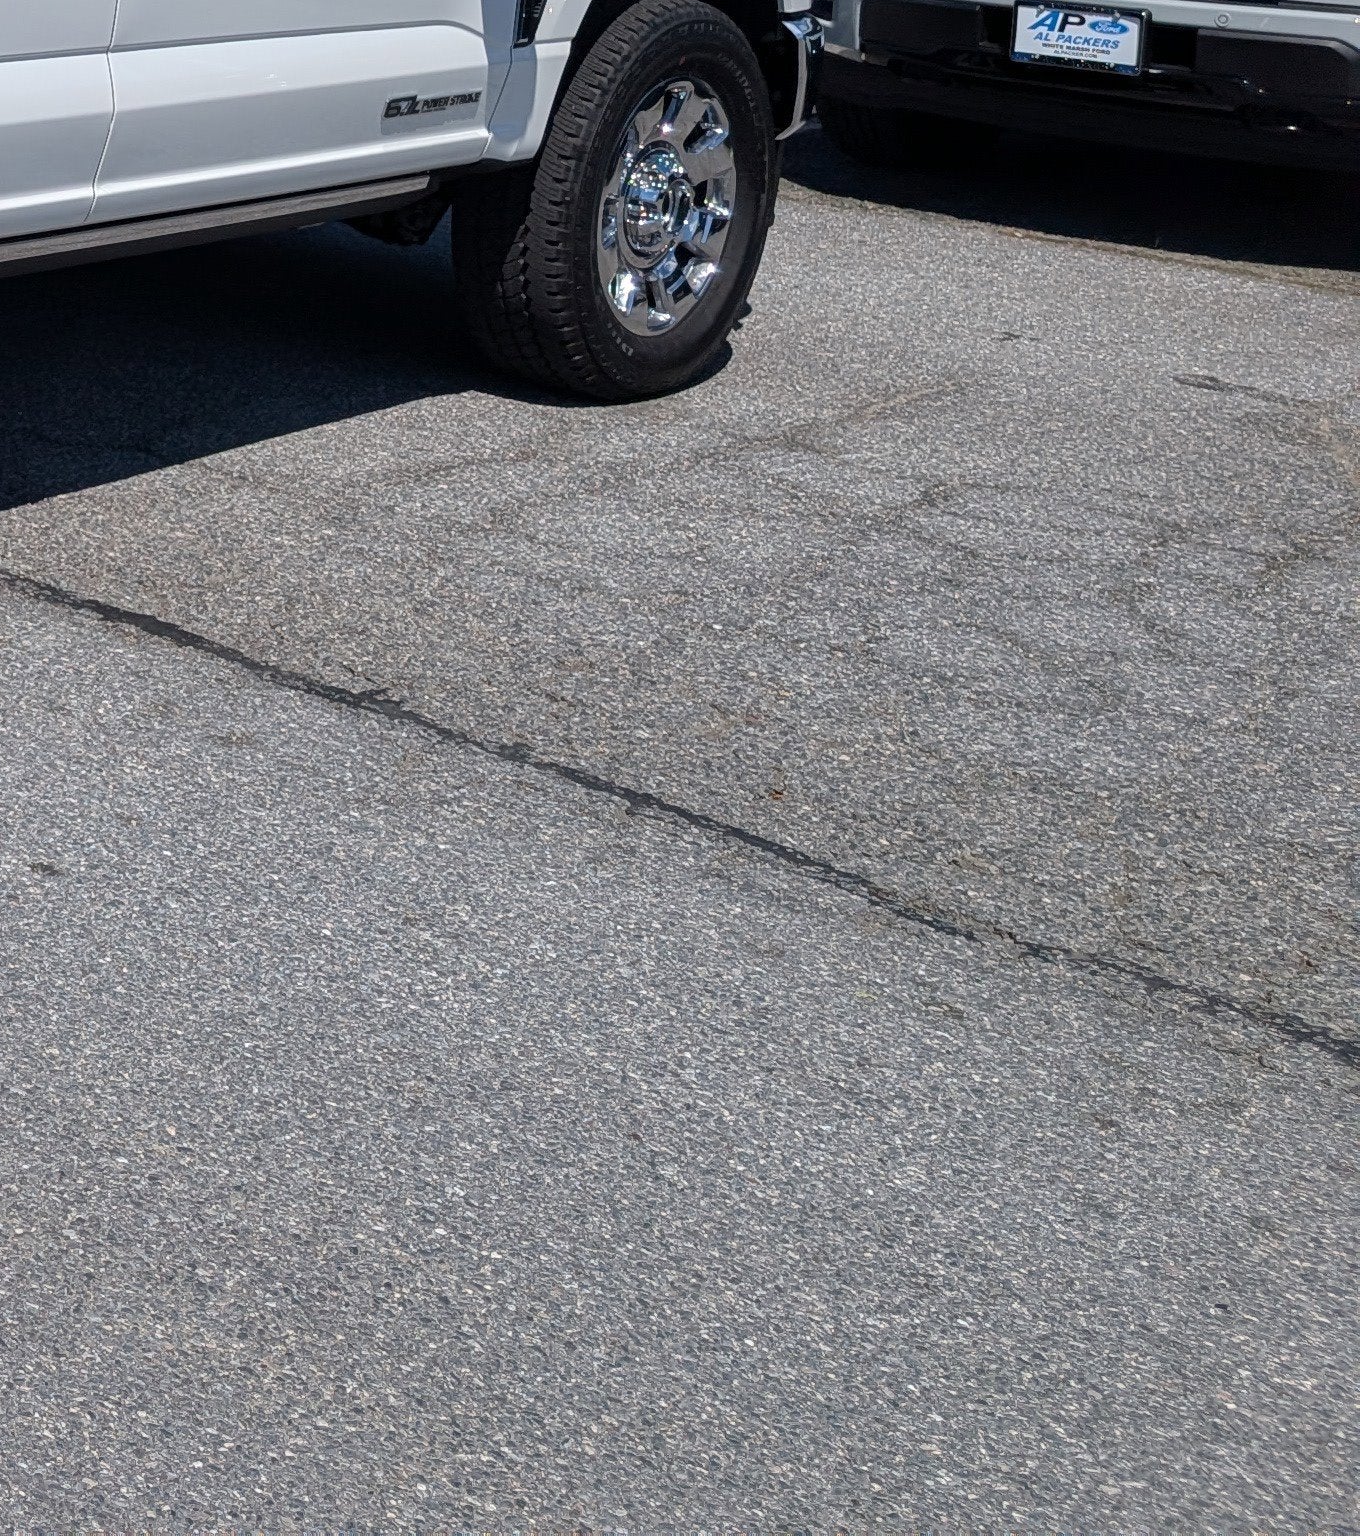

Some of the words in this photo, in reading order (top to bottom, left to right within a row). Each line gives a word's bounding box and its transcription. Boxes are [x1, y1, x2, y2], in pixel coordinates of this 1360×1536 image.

[1027, 10, 1086, 33] AP
[1033, 31, 1052, 42] AL
[1055, 33, 1121, 50] PACKERS
[1042, 42, 1064, 50] WHITE
[1065, 44, 1091, 52] MARSH
[1091, 47, 1111, 55] FORD
